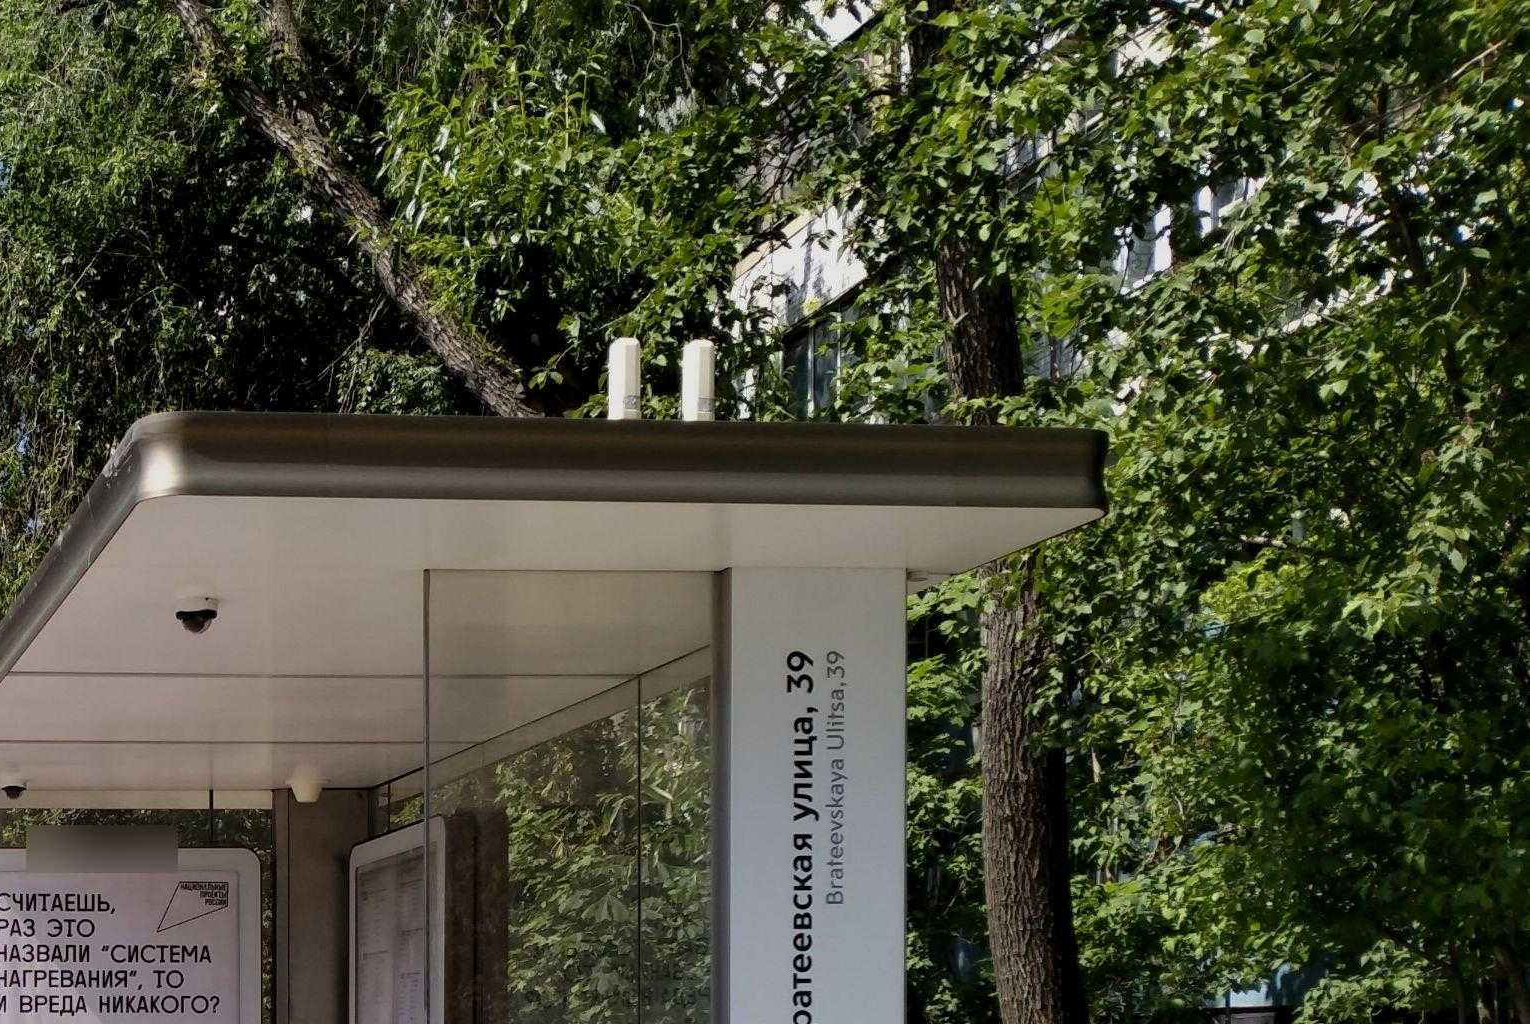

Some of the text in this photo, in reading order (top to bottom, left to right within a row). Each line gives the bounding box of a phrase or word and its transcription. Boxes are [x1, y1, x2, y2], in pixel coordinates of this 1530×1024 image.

[786, 650, 814, 693] 39
[793, 706, 819, 822] улица,
[825, 757, 849, 905] Brateevskaya
[47, 919, 95, 938] ЭТО
[153, 969, 184, 988] ТО
[20, 995, 87, 1016] ВРЕДА
[99, 995, 220, 1014] НИКАКОГО?
